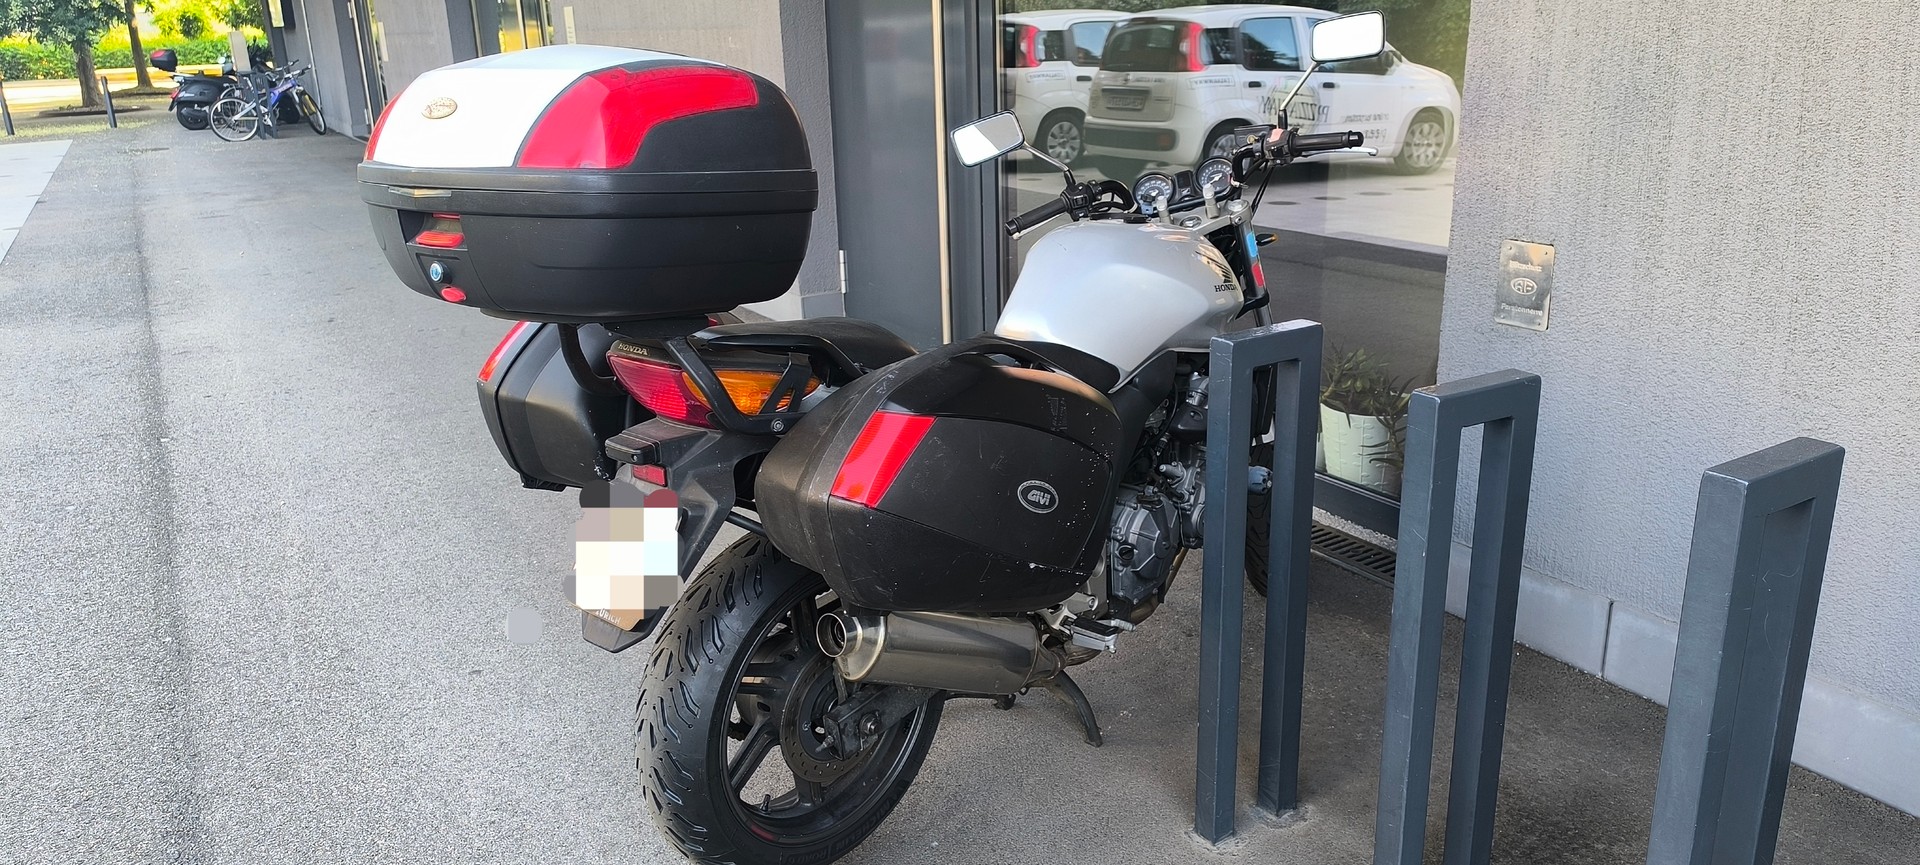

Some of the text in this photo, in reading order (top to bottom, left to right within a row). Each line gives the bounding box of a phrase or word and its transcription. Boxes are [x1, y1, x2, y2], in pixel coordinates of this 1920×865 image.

[1214, 284, 1239, 292] HONDA
[618, 342, 648, 355] HONDA
[1027, 489, 1052, 506] GIVI
